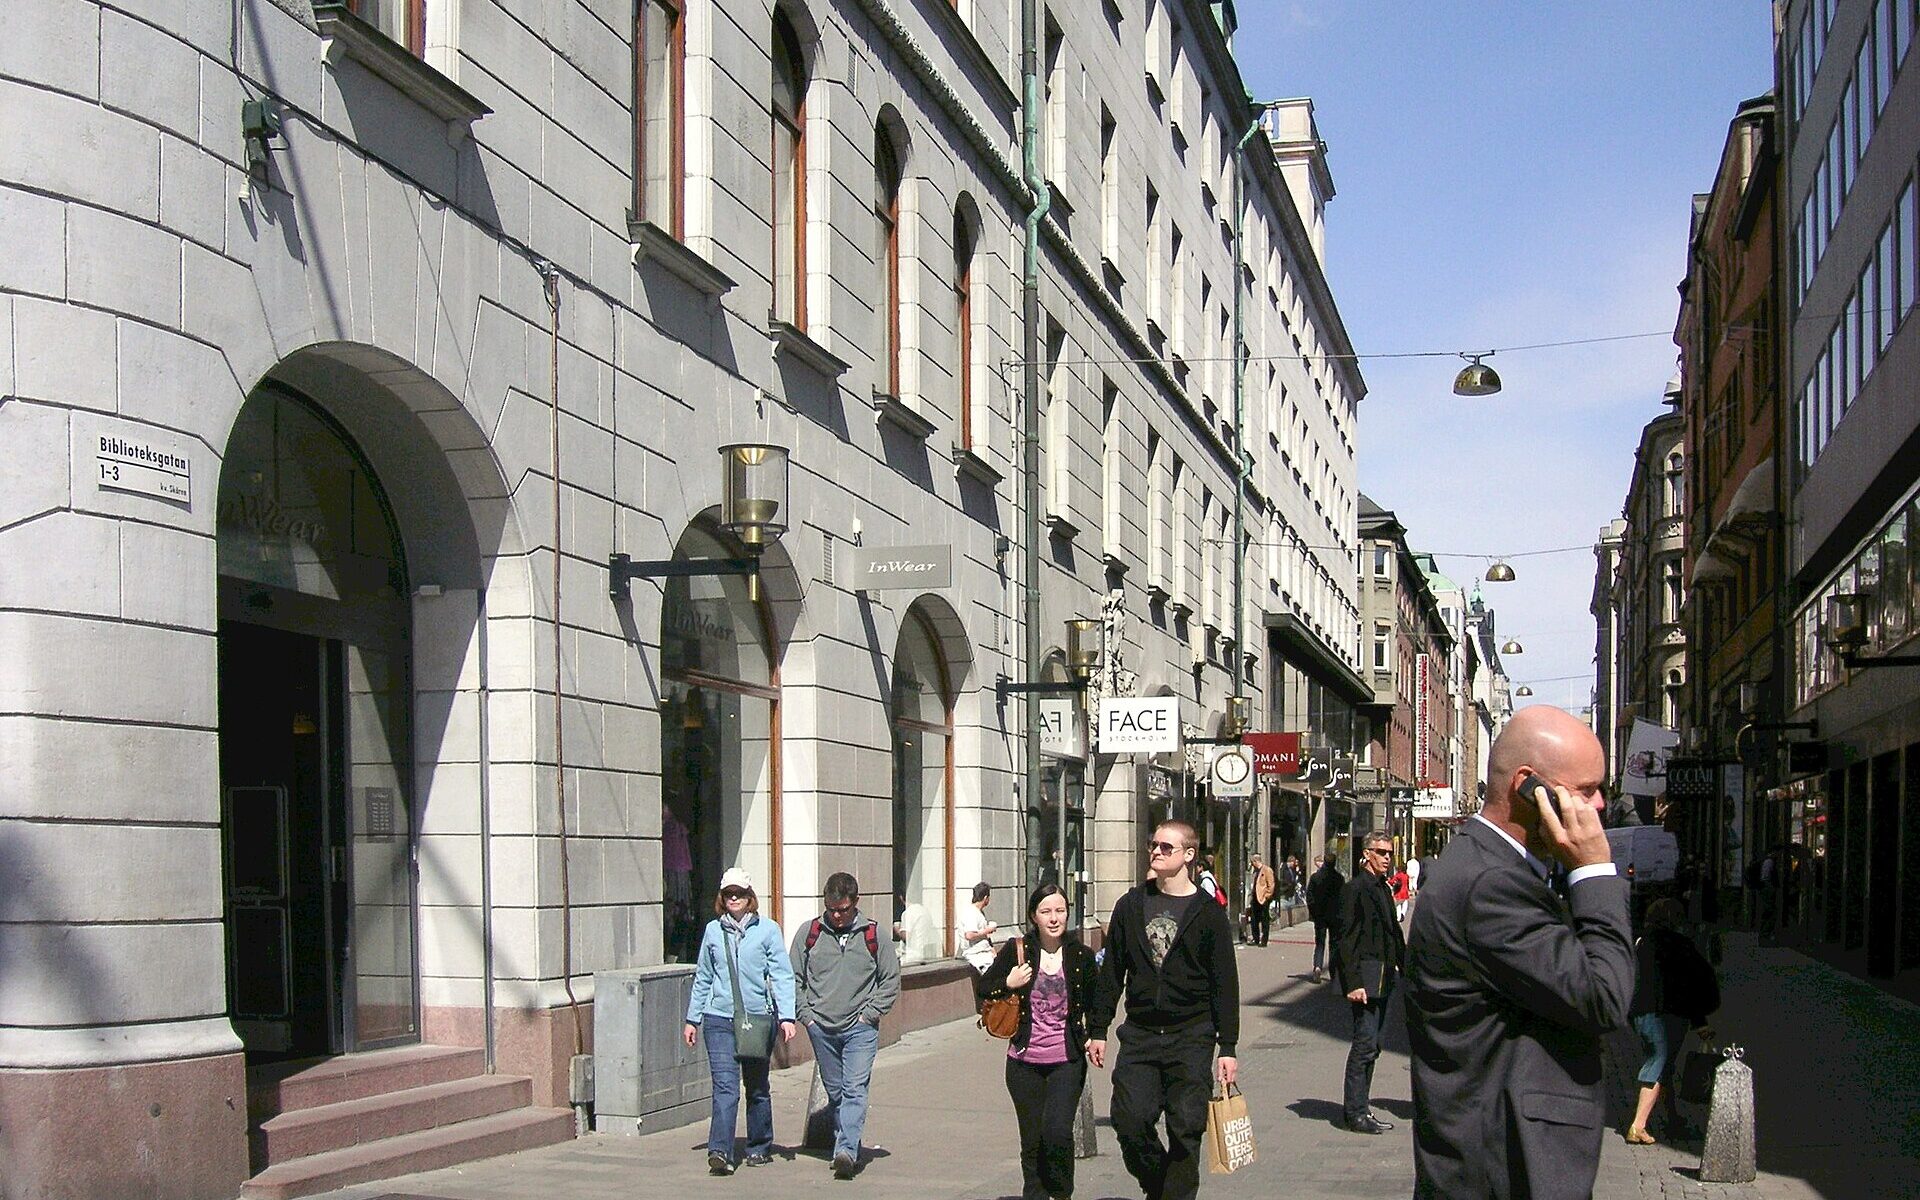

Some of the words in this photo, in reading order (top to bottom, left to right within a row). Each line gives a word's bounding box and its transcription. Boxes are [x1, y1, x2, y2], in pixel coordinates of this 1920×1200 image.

[100, 436, 186, 470] Biblioteksgatan
[100, 464, 120, 481] 1-3
[867, 560, 937, 574] InWear
[1109, 709, 1167, 732] FACE
[1227, 1142, 1254, 1159] TERS
